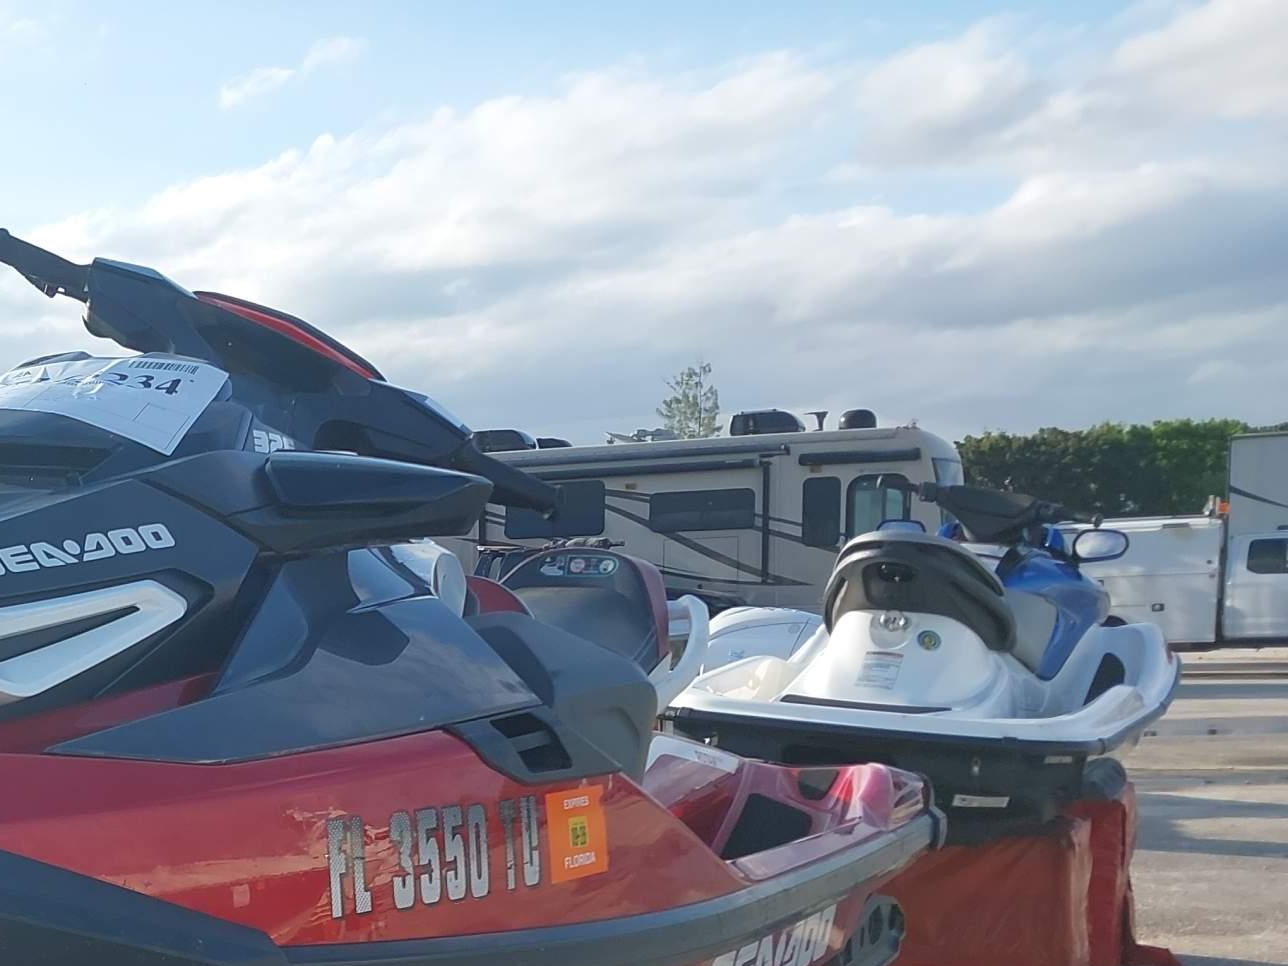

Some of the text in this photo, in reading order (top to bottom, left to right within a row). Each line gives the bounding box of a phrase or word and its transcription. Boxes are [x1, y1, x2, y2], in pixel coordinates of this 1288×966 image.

[327, 816, 372, 919] FL
[390, 803, 489, 910] 3550
[564, 851, 596, 870] FLORIDA
